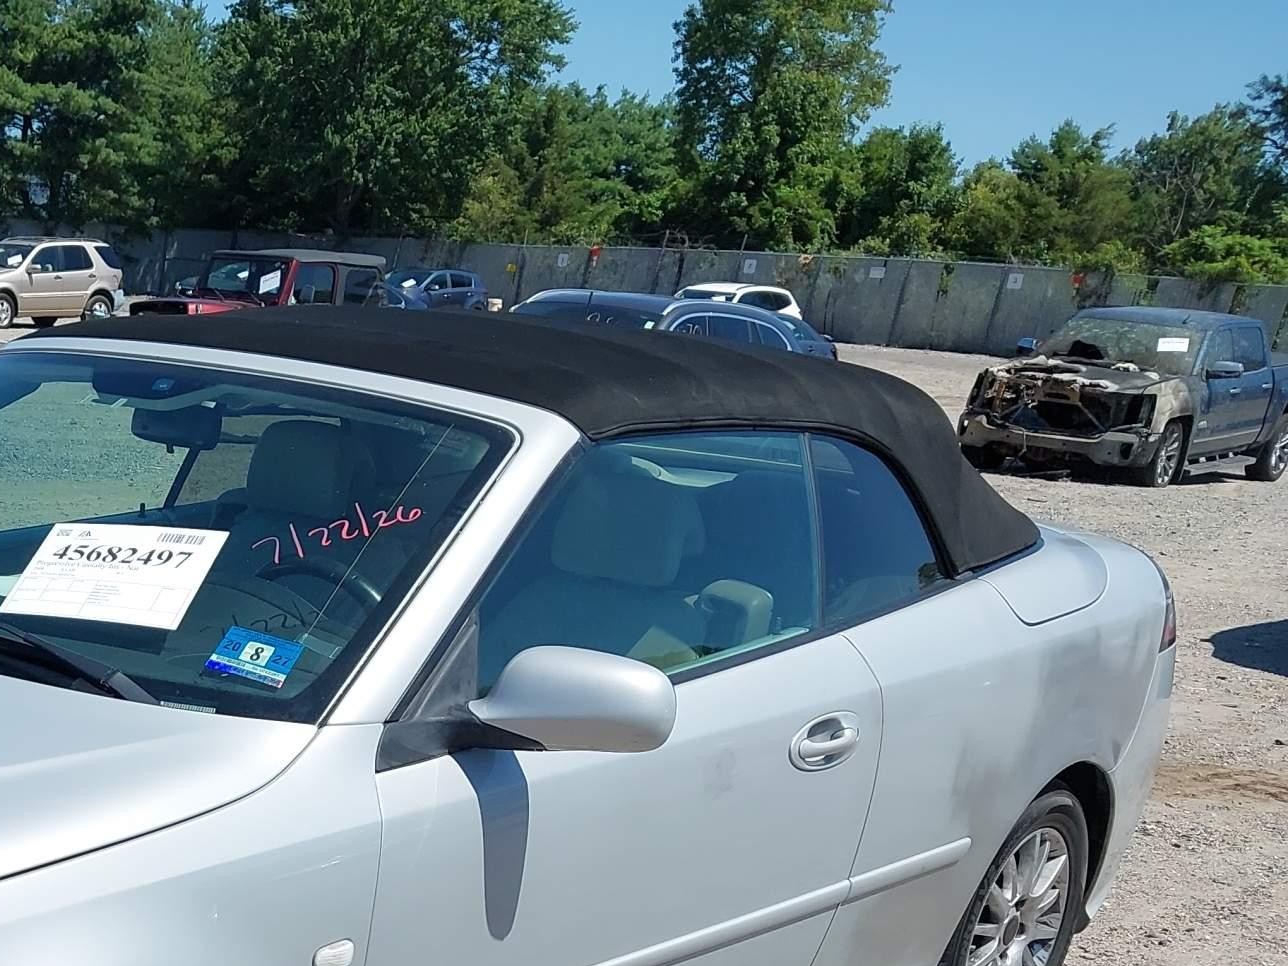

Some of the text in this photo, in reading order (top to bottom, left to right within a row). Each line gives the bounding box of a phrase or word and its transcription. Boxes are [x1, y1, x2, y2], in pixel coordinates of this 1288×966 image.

[252, 502, 422, 564] 7/22/26
[52, 543, 194, 569] 45682497
[223, 640, 242, 652] 20
[249, 646, 265, 661] 8
[272, 655, 291, 667] 27
